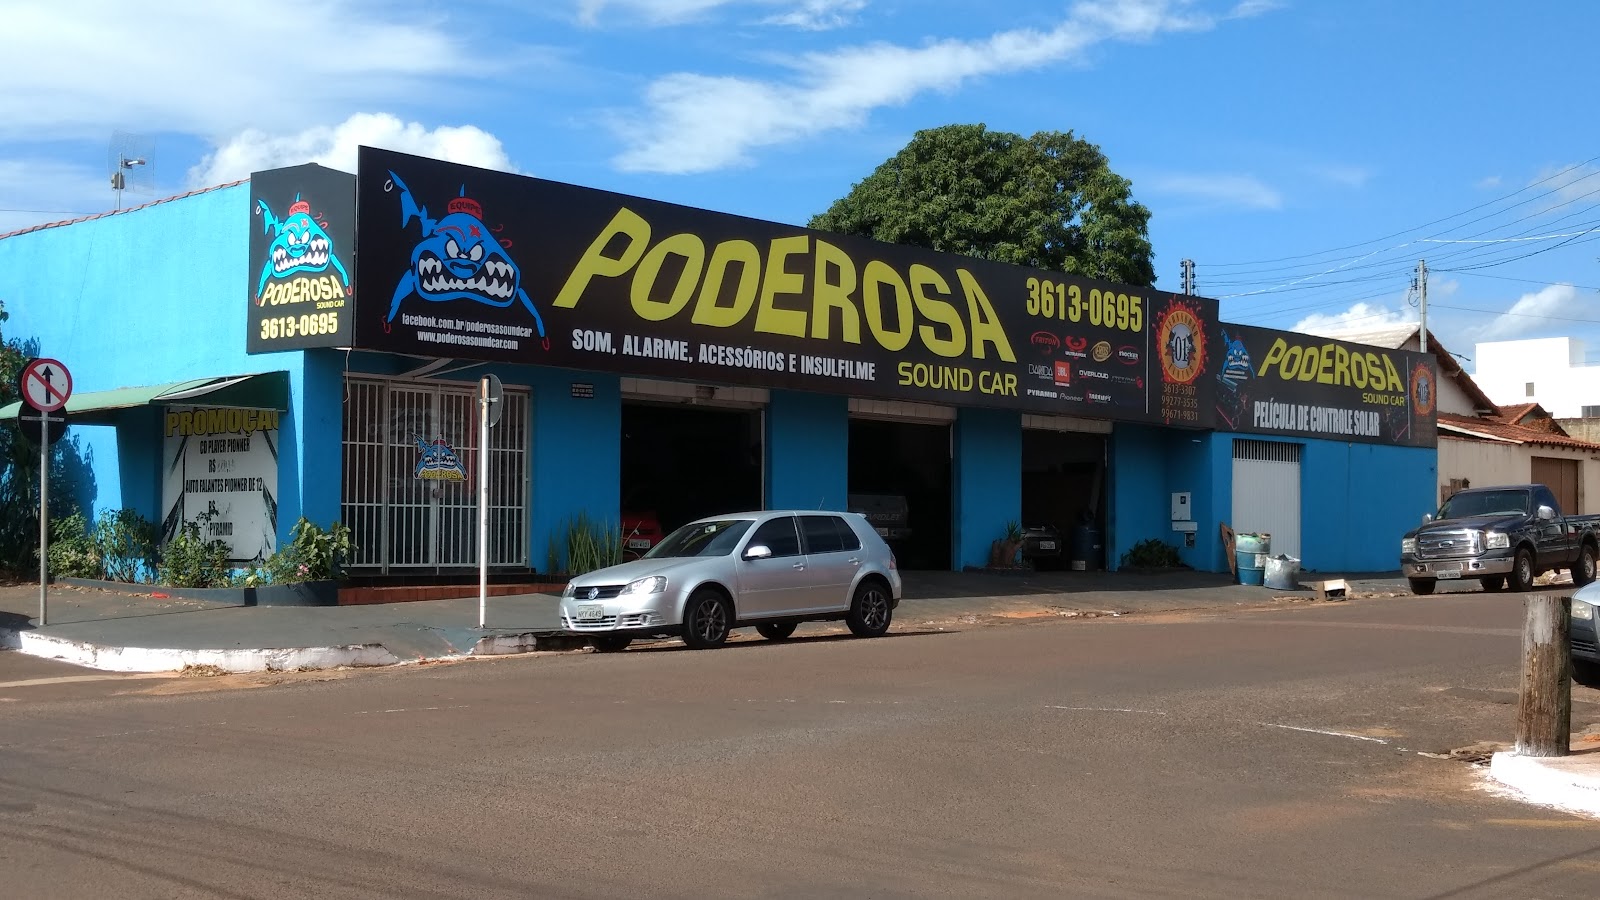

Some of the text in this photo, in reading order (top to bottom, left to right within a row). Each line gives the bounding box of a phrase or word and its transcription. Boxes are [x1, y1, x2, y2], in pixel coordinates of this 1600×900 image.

[260, 275, 344, 307] PODEROSA
[552, 207, 1017, 362] PODEROSA
[316, 300, 345, 310] SOUND CAR
[1026, 277, 1143, 332] 3613-0695
[260, 312, 338, 340] 3613-0695
[402, 313, 533, 338] facebook.com.br/poderosasoundcar
[417, 331, 519, 350] www.poderosasoundcar.com
[572, 328, 876, 381] SOM, ALARME, ACESSÓRIOS E INSULFILME
[1257, 337, 1404, 393] PODEROSA
[898, 361, 1018, 397] SOUND CAR
[1027, 388, 1058, 399] PYRAMID
[1362, 392, 1405, 407] SOUND CAR
[1253, 397, 1380, 437] PELÍCULA DE CONTROLE SOLAR
[199, 440, 207, 455] CD
[208, 439, 226, 454] PLAYER
[185, 479, 199, 493] AUTO
[199, 478, 224, 492] FALANTES
[248, 477, 256, 492] DE
[209, 522, 233, 536] PYRAMID
